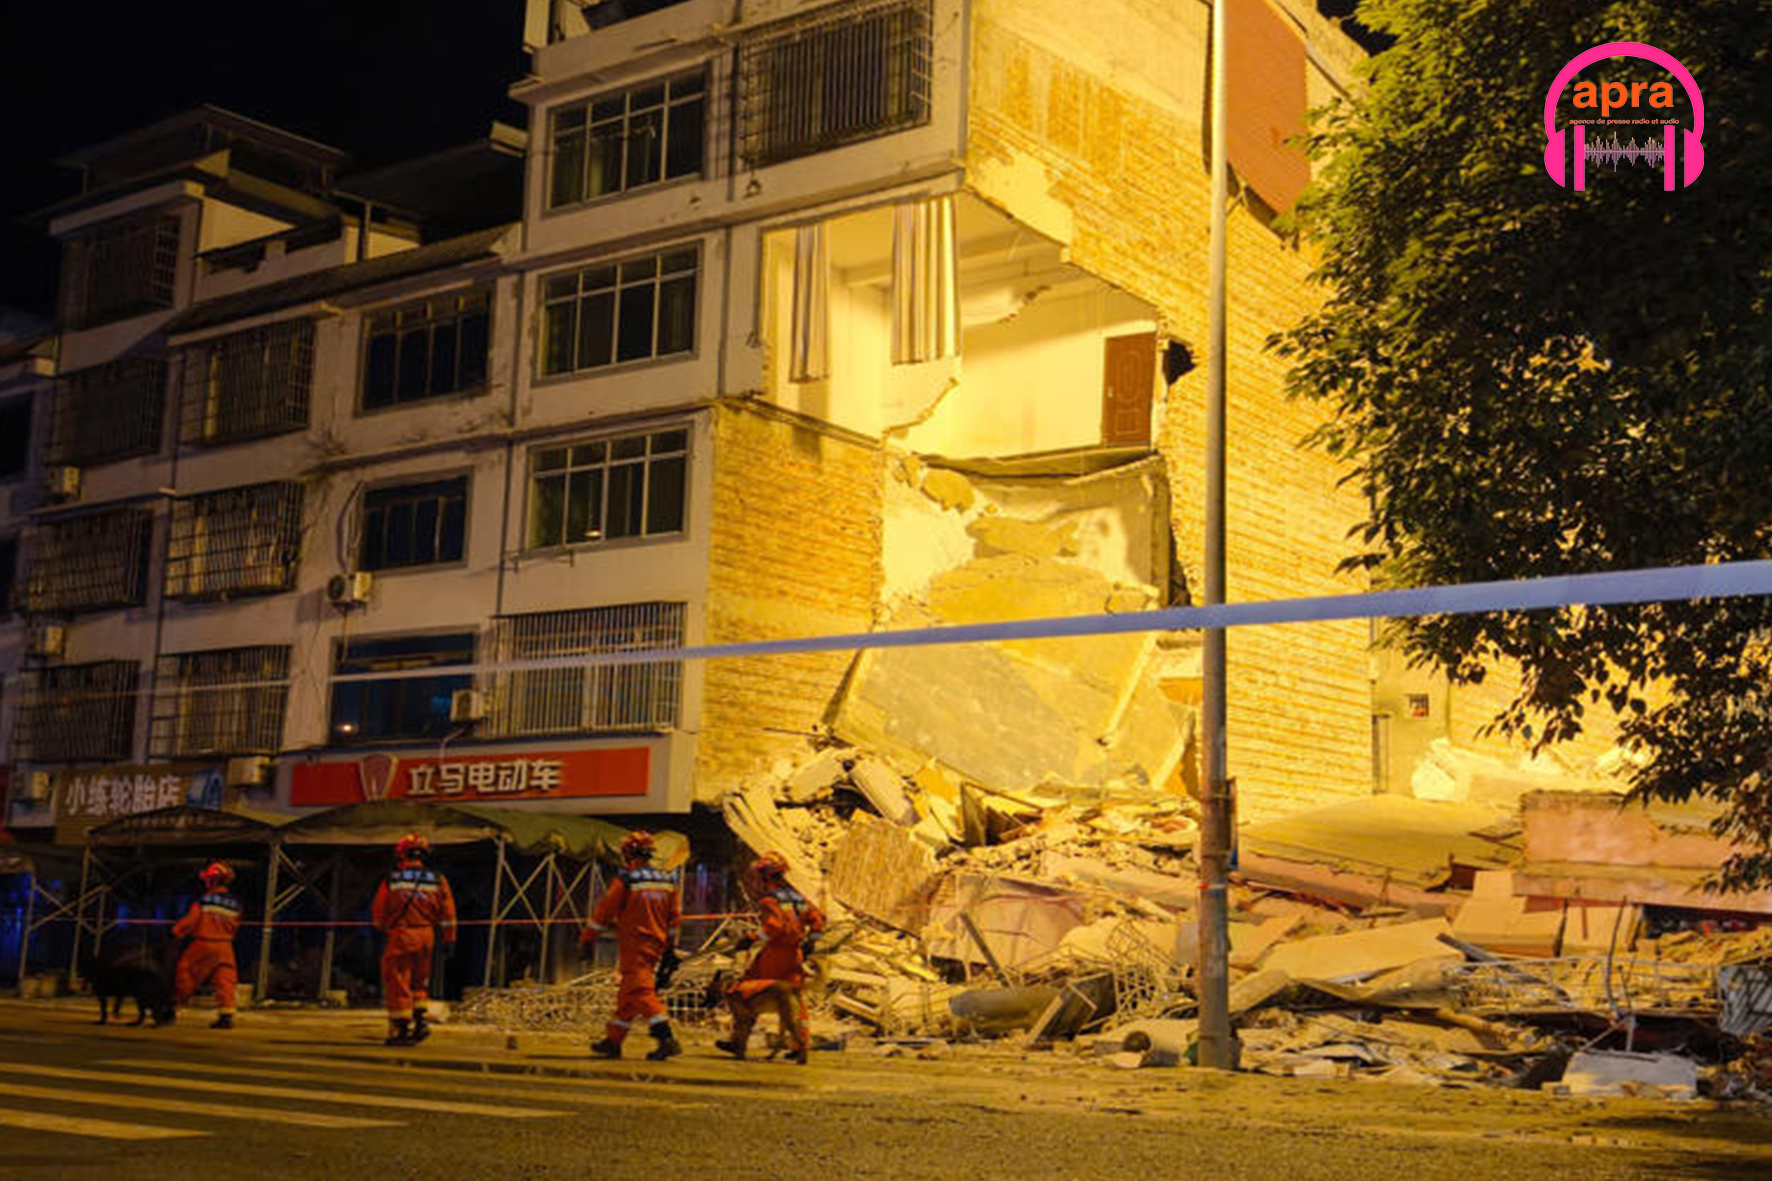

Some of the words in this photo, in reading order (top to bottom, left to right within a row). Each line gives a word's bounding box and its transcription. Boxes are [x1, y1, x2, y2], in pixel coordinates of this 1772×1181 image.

[408, 758, 562, 796] 立马电动车
